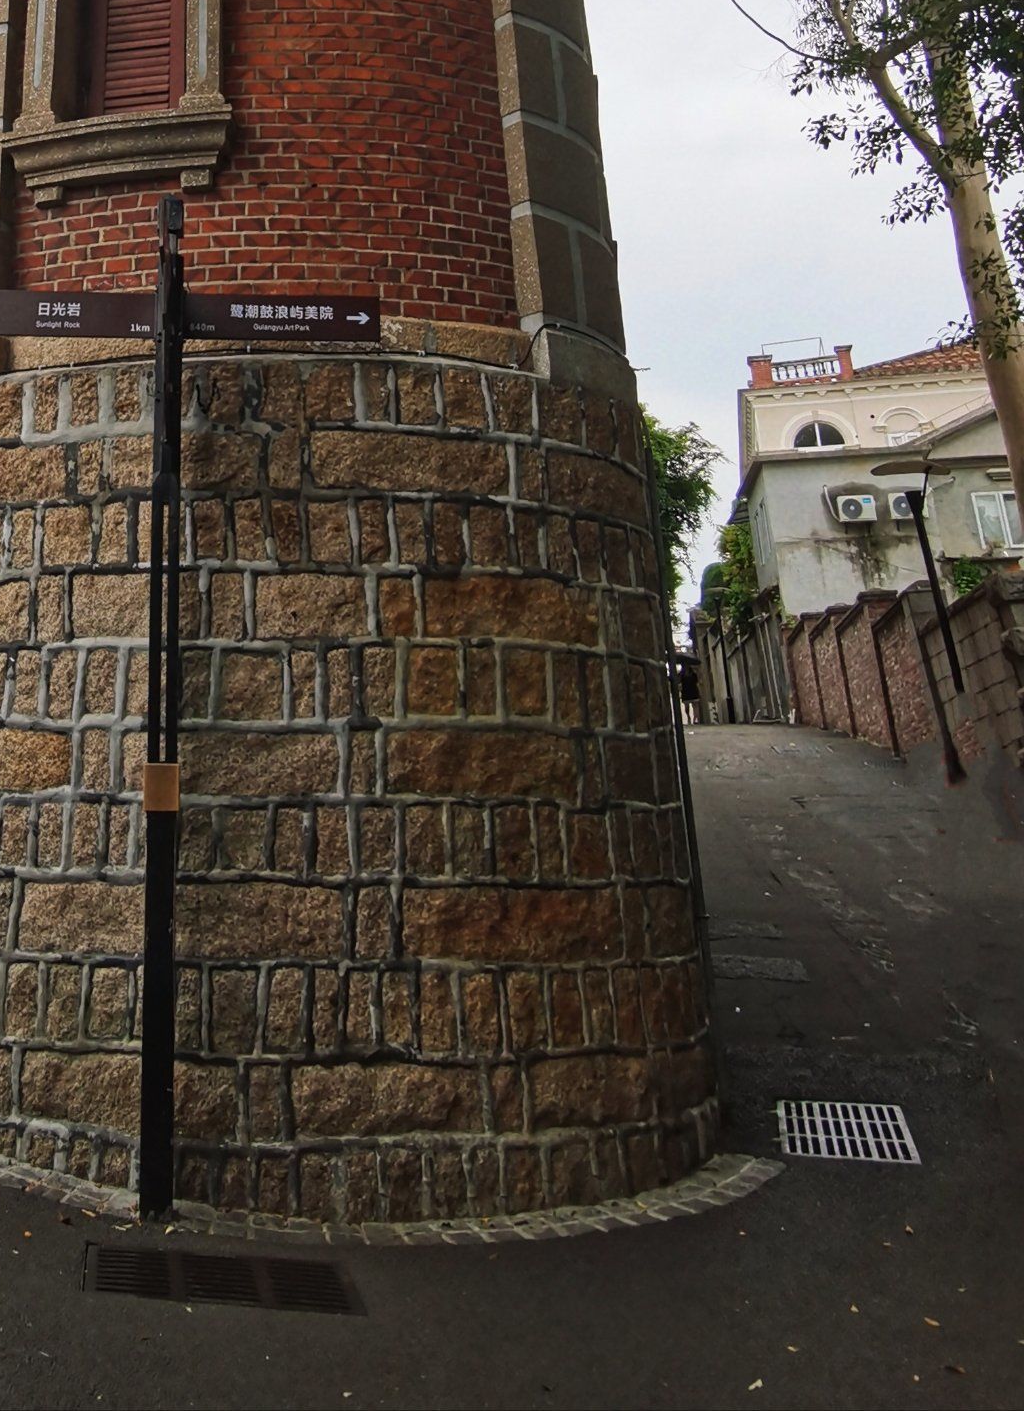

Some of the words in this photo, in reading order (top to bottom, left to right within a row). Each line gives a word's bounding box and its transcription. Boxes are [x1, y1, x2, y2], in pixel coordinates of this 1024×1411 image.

[38, 302, 81, 317] 日光岩
[230, 303, 334, 320] 鹭潮鼓浪屿美院
[36, 320, 62, 329] Sunlight
[64, 321, 81, 329] Rock
[130, 323, 151, 332] 1km
[253, 322, 283, 332] Gulangyu
[284, 323, 295, 331] Art
[295, 323, 310, 331] Park
